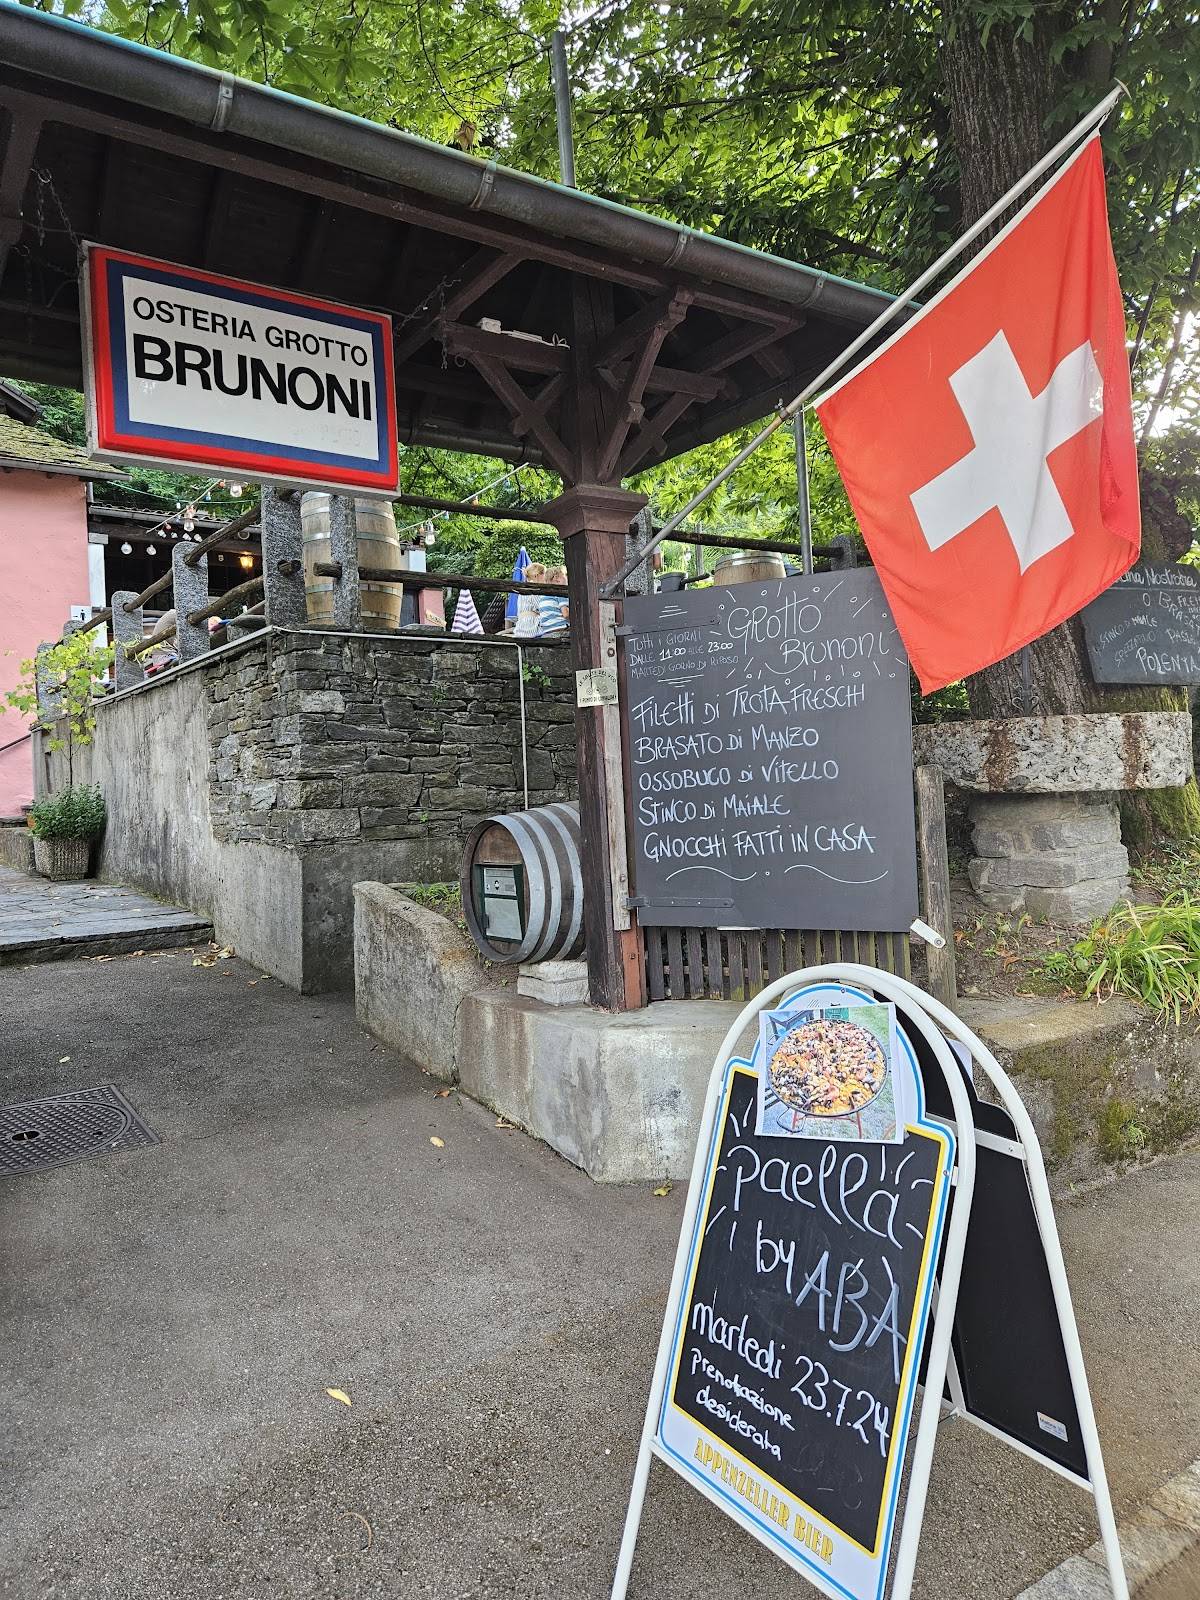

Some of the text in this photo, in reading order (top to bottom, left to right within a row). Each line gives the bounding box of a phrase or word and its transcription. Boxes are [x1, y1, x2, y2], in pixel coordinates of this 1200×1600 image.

[133, 296, 368, 367] OSTERIA GROTTO
[133, 333, 372, 421] BRUNONI
[629, 652, 656, 667] DALLE
[668, 661, 696, 672] GIORNO
[726, 684, 790, 719] TROTA
[790, 683, 865, 712] FRESCHI
[634, 732, 723, 764] BRASATO
[752, 724, 819, 751] MANZO
[639, 767, 731, 792] OSSOBUCO
[814, 823, 877, 853] CASA
[757, 1219, 796, 1294] by
[691, 1348, 796, 1431] prenotazione
[696, 1385, 781, 1461] desiderata
[790, 1355, 890, 1457] 23.7.24
[694, 1437, 835, 1566] APPENZELLER BIER
